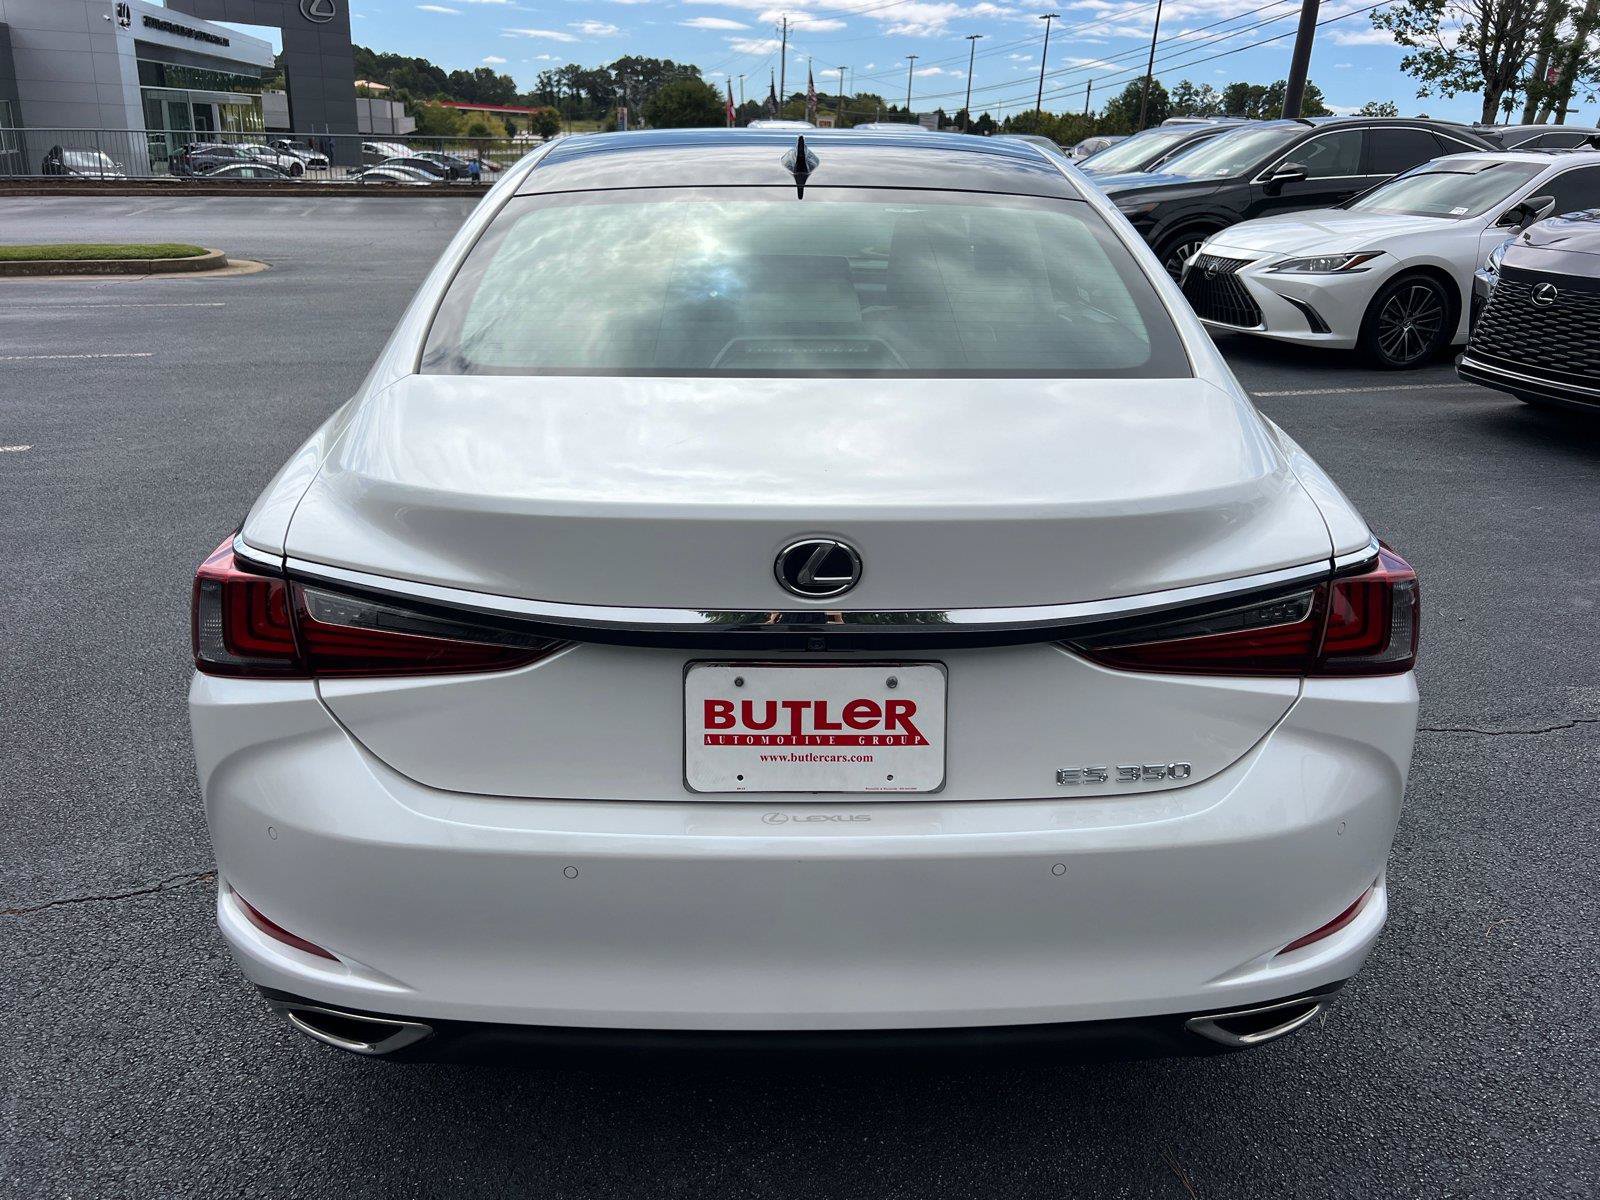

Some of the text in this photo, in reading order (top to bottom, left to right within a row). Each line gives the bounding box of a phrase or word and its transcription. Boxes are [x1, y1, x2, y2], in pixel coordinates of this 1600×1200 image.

[704, 735, 922, 745] AUTOMOTIVE GROUP
[760, 752, 874, 763] www.butlercars.com
[1056, 761, 1192, 786] ES 350
[792, 814, 872, 823] LEXUS
